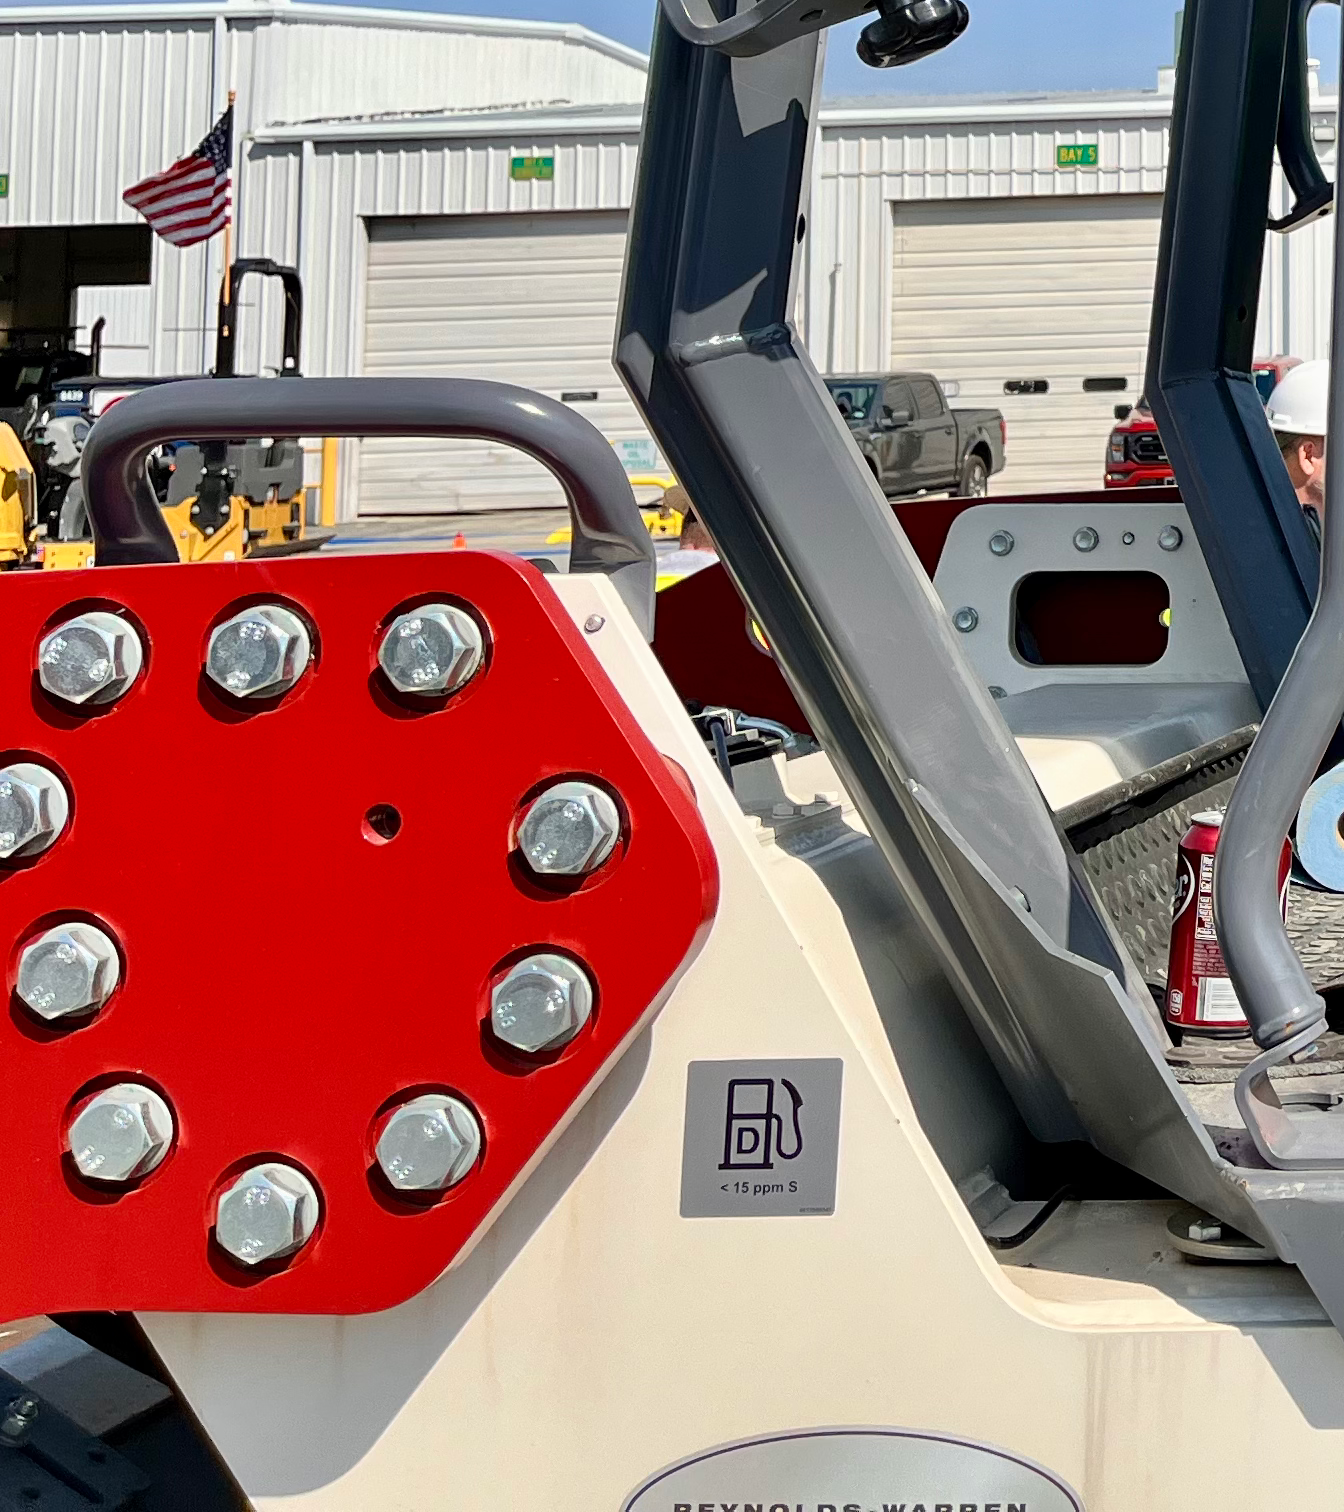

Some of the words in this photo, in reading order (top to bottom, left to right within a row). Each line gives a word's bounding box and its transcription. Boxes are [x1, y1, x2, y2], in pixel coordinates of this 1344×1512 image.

[1060, 147, 1083, 162] BAY
[1088, 147, 1096, 162] 5
[736, 1127, 760, 1154] D
[733, 1181, 750, 1193] 15
[753, 1182, 784, 1196] ppm
[788, 1180, 799, 1193] S
